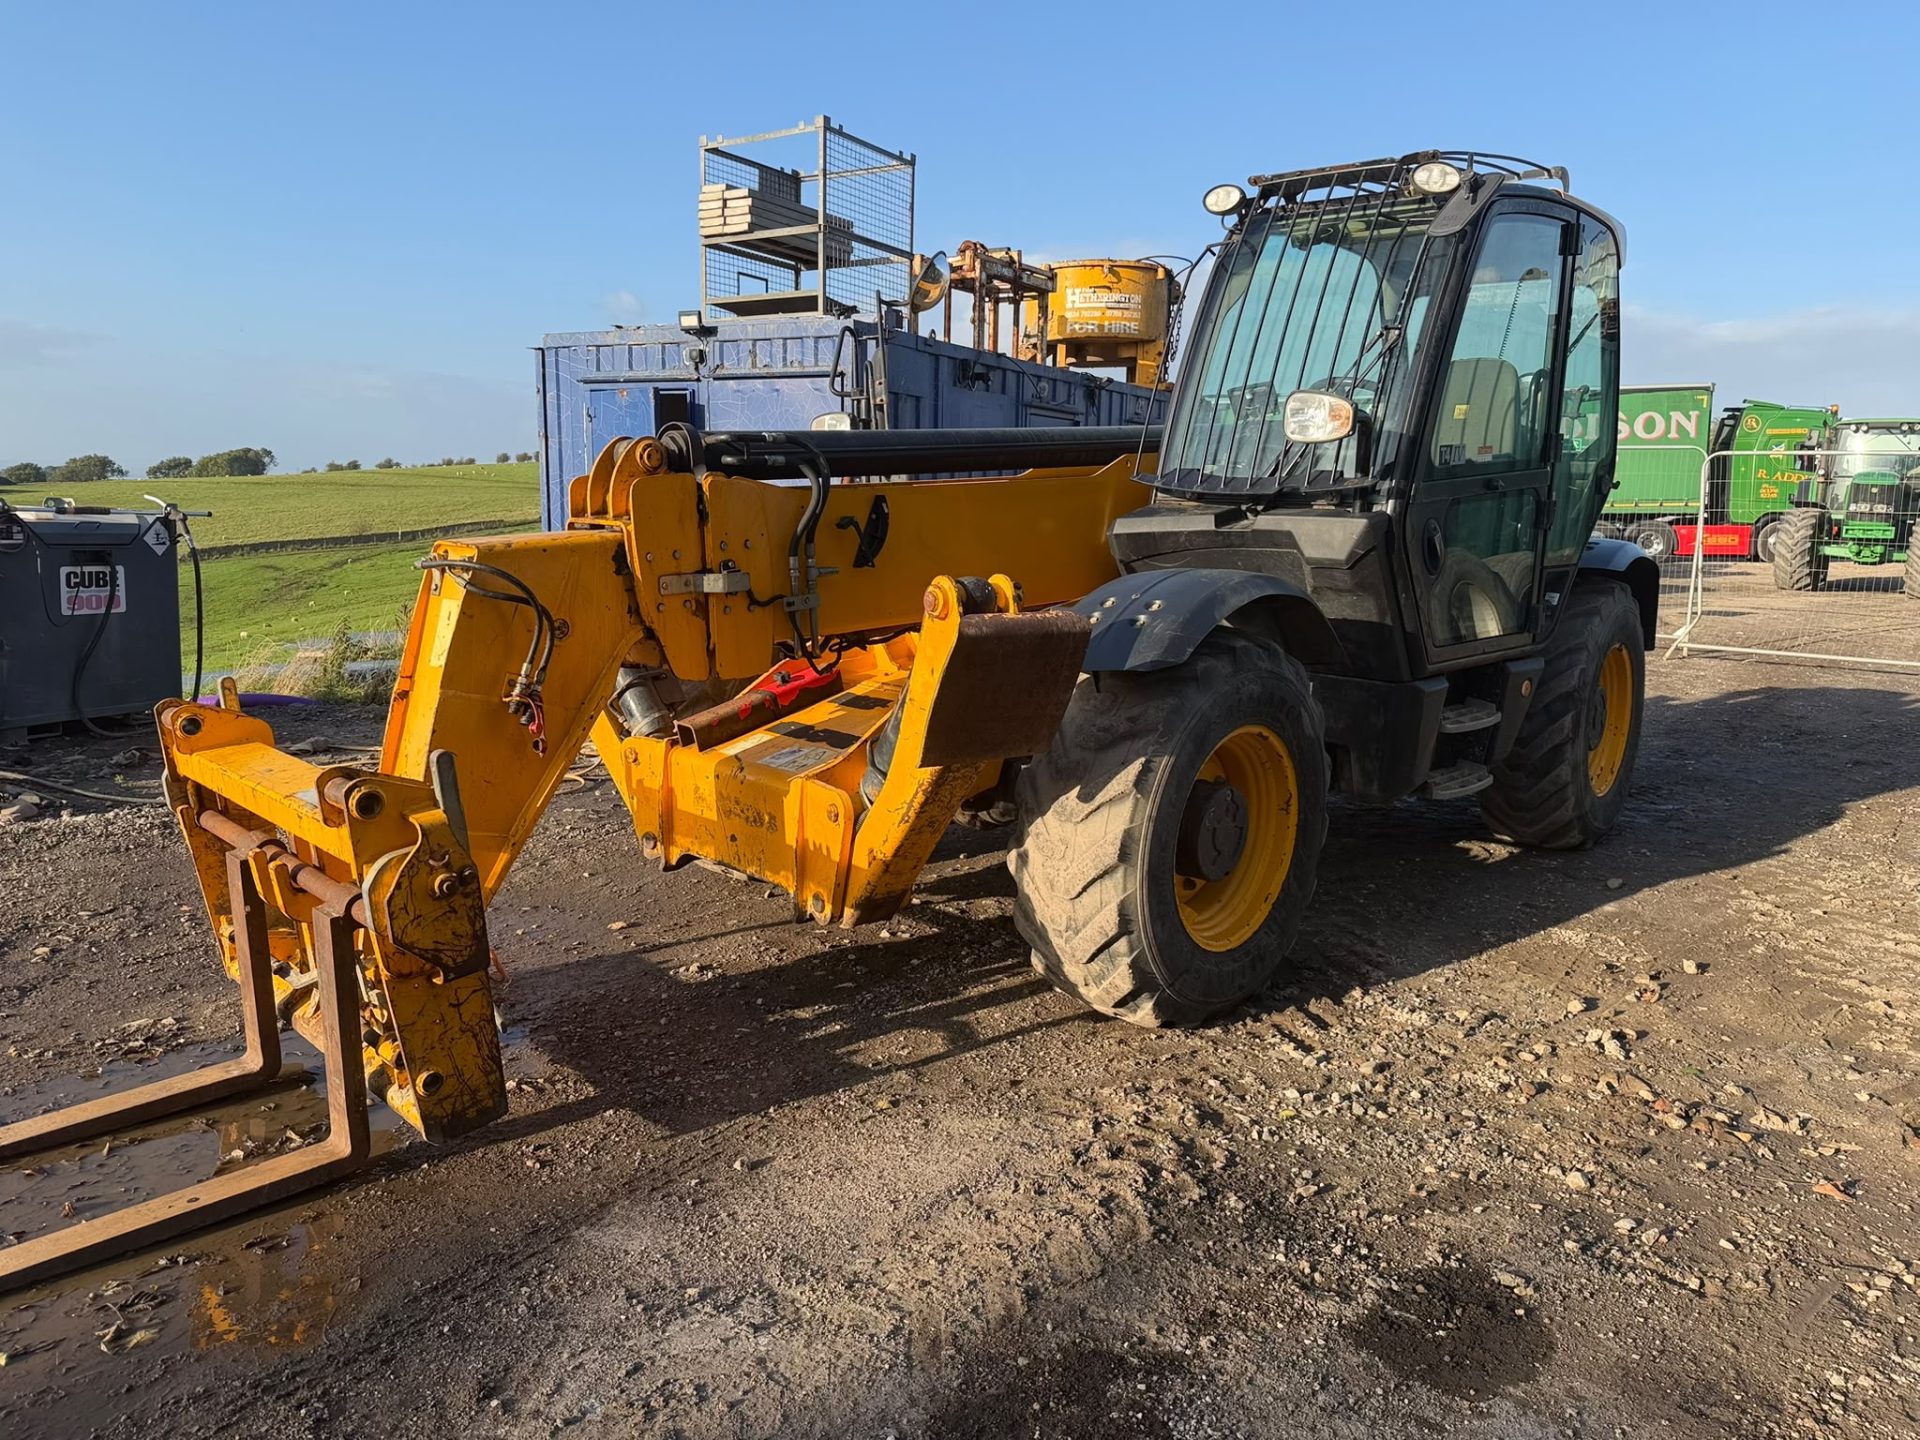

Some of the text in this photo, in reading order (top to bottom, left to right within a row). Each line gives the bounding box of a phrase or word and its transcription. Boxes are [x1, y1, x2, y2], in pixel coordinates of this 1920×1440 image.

[1067, 321, 1139, 334] FOR HIRE
[1772, 471, 1810, 484] ADD
[67, 594, 121, 611] 900
